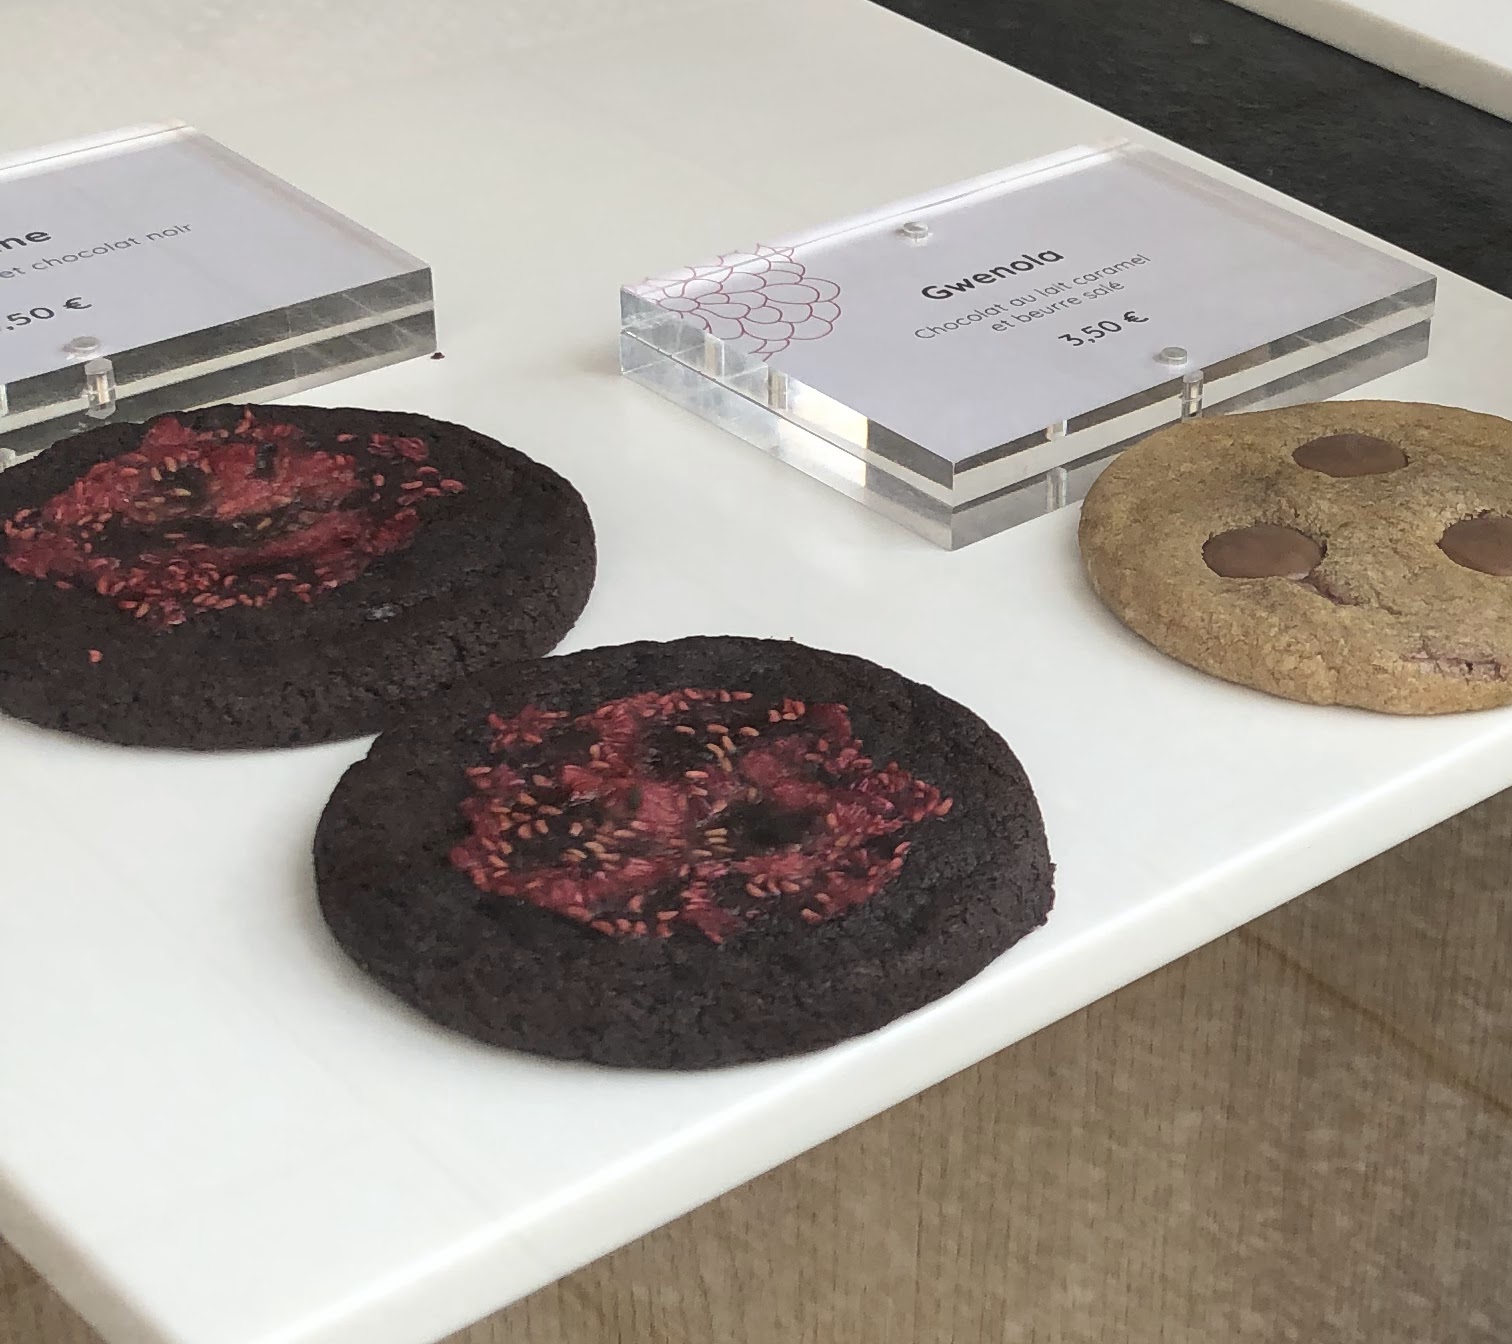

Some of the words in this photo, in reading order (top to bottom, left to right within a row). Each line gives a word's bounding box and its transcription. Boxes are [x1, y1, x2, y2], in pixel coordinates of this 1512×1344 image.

[32, 236, 142, 271] chocolat
[145, 223, 192, 242] noir
[914, 303, 1009, 340] Chocolat
[1009, 293, 1037, 307] au
[1033, 281, 1073, 298] lait
[1073, 253, 1151, 285] caramel
[921, 250, 1065, 301] Gwenola
[0, 307, 55, 331] ,50
[63, 296, 93, 310] €
[991, 319, 1016, 333] et
[1011, 296, 1083, 324] beurre
[1083, 280, 1125, 300] salé
[1058, 320, 1122, 347] 3,50
[1123, 310, 1150, 323] €
